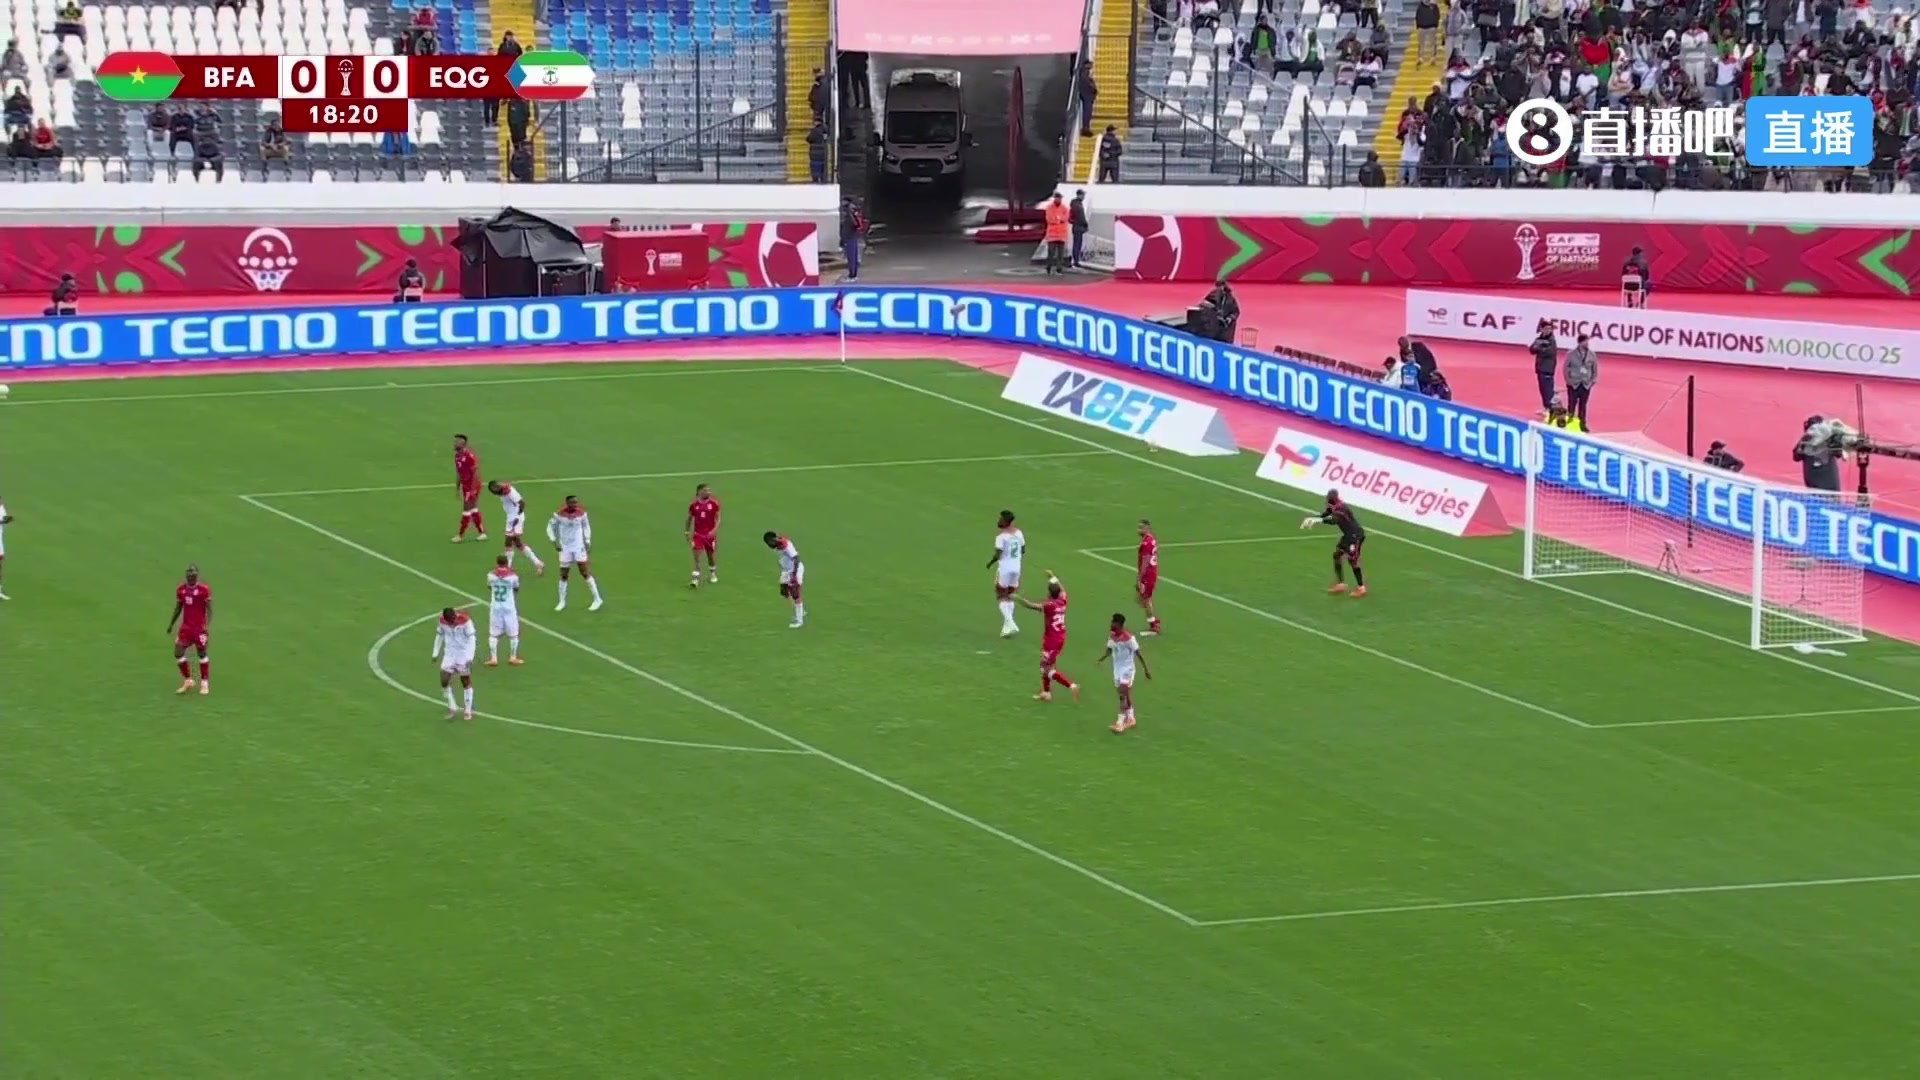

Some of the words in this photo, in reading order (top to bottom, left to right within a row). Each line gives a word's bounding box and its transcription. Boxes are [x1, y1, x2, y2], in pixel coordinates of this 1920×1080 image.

[1463, 311, 1517, 330] CAF
[1607, 323, 1644, 342] CUP
[1648, 326, 1674, 345] OF
[1679, 329, 1764, 354] NATIONS
[1767, 337, 1874, 362] MOROCCO
[1879, 346, 1902, 364] 25
[0, 321, 102, 363] NO
[124, 311, 337, 357] TECNO
[358, 303, 561, 347] TECNO
[581, 294, 780, 338] TECNO
[800, 292, 992, 333] TECNO
[1005, 300, 1117, 356] TECNO
[1125, 324, 1215, 384] TECNO
[1223, 350, 1319, 413] TECNO
[1328, 378, 1427, 442] TECNO
[1437, 406, 1544, 474] TECNO
[1553, 437, 1669, 508] TECNO
[1679, 470, 1807, 546] TECNO
[1041, 370, 1177, 435] 1XBET
[1320, 455, 1470, 520] TotalEnergies
